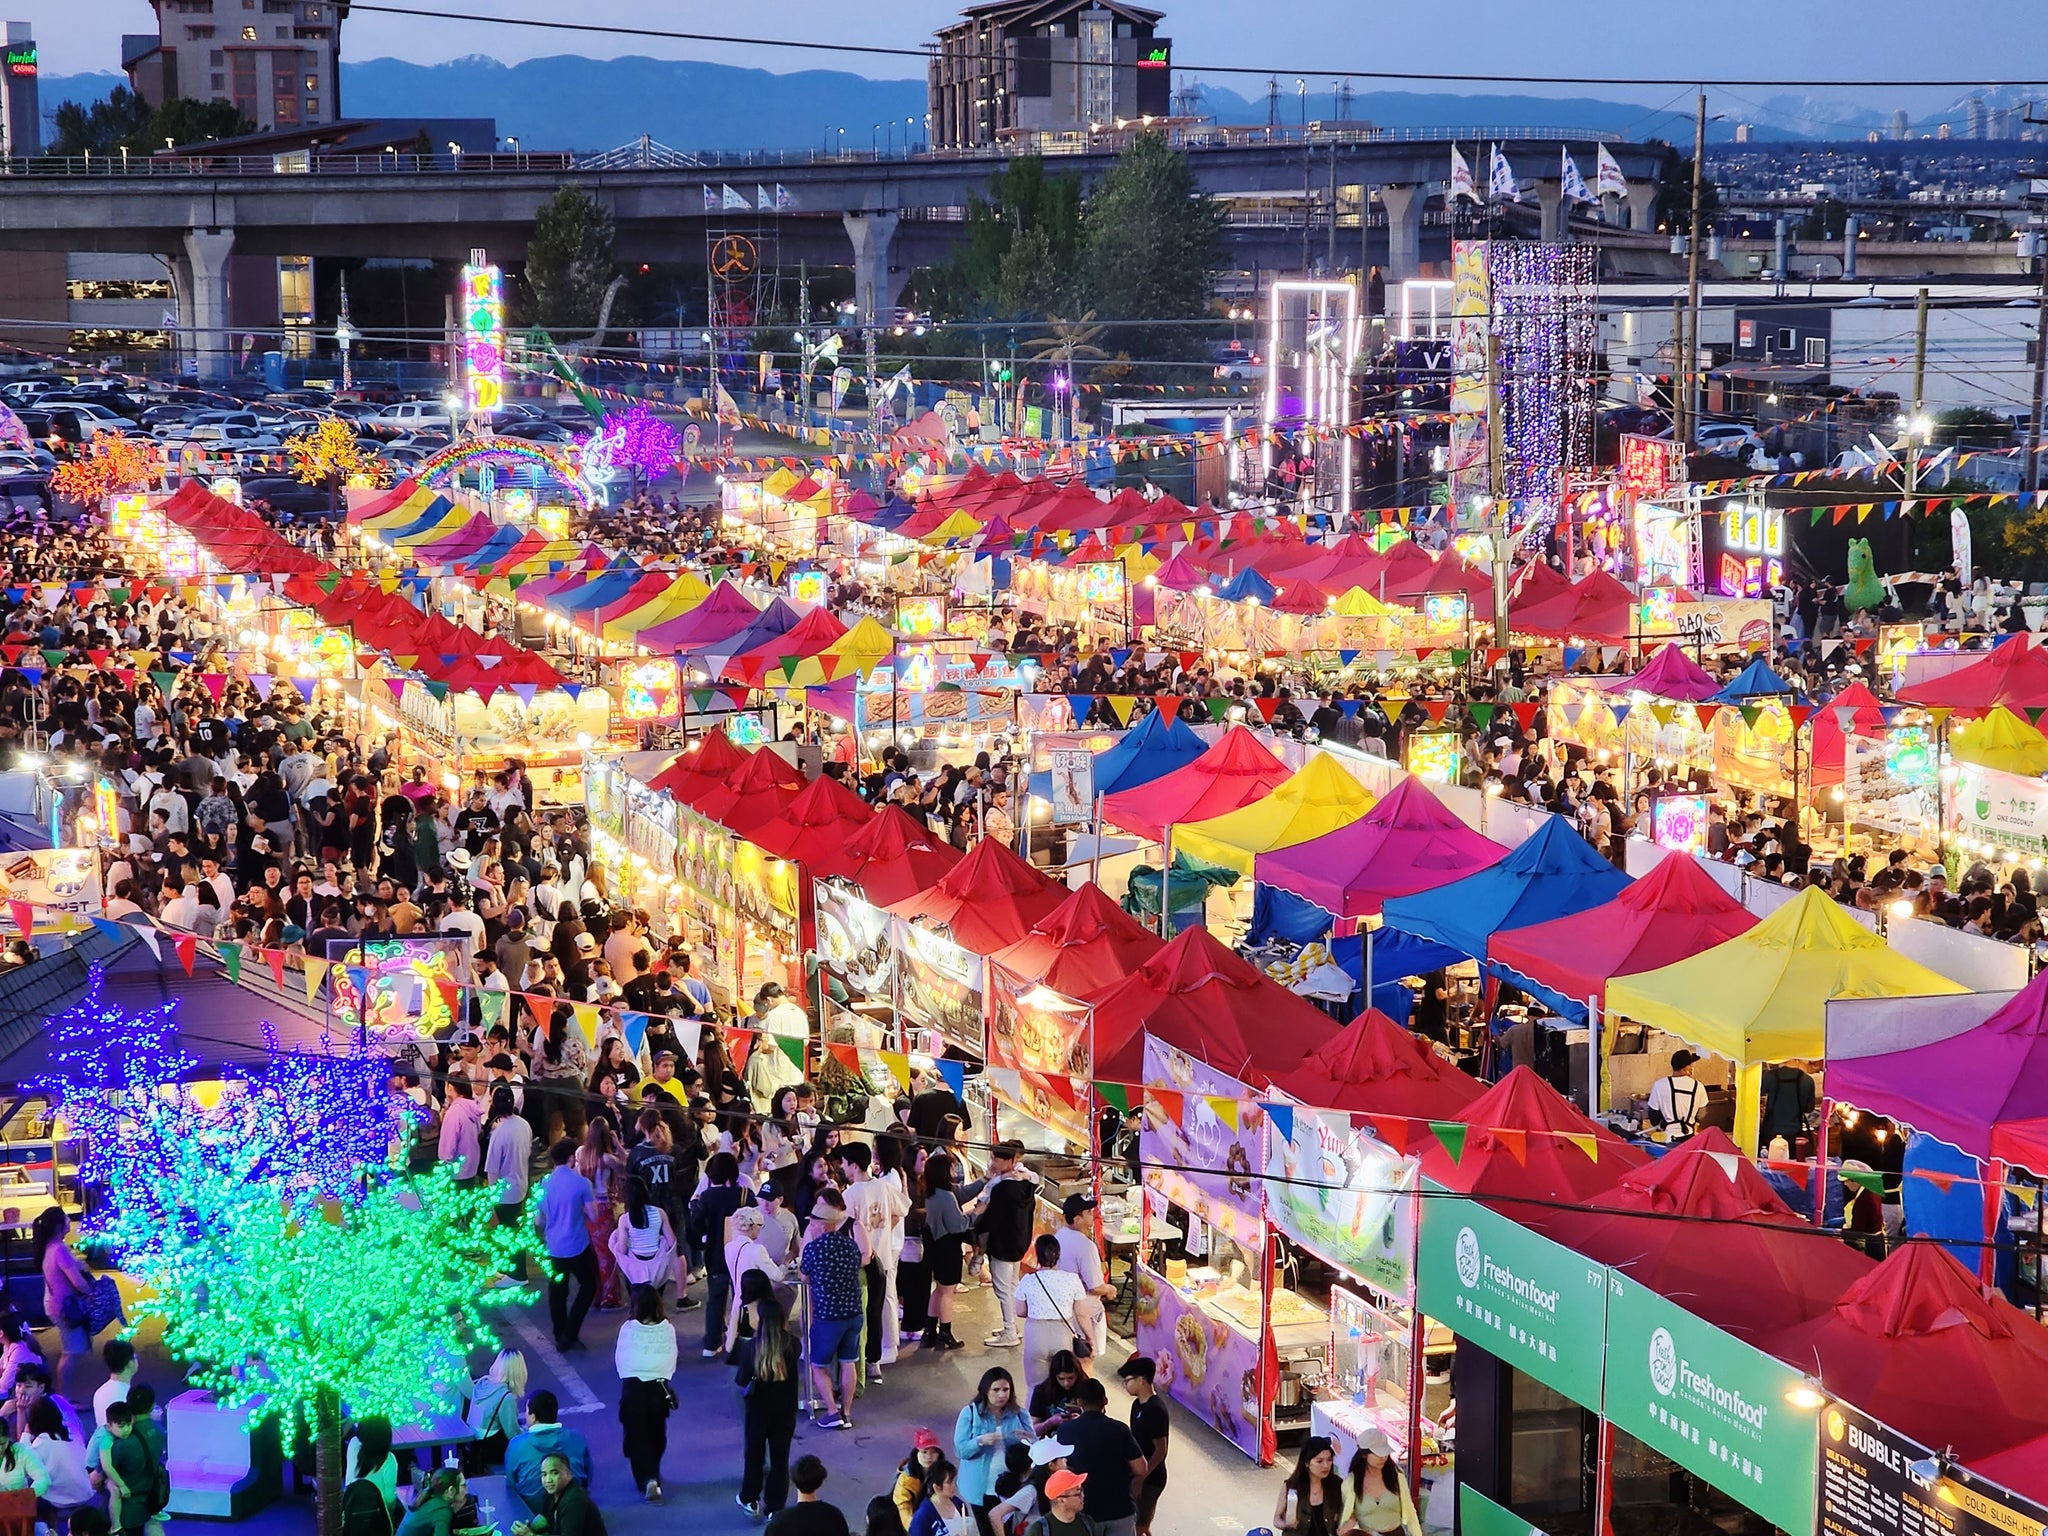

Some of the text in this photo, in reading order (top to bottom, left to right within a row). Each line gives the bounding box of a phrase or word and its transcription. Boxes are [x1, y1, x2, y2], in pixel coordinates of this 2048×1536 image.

[199, 729, 212, 741] 10
[650, 1164, 669, 1184] XI
[1587, 1269, 1601, 1289] F77
[1610, 1277, 1624, 1297] F76
[1848, 1424, 1901, 1474] BUBBLE
